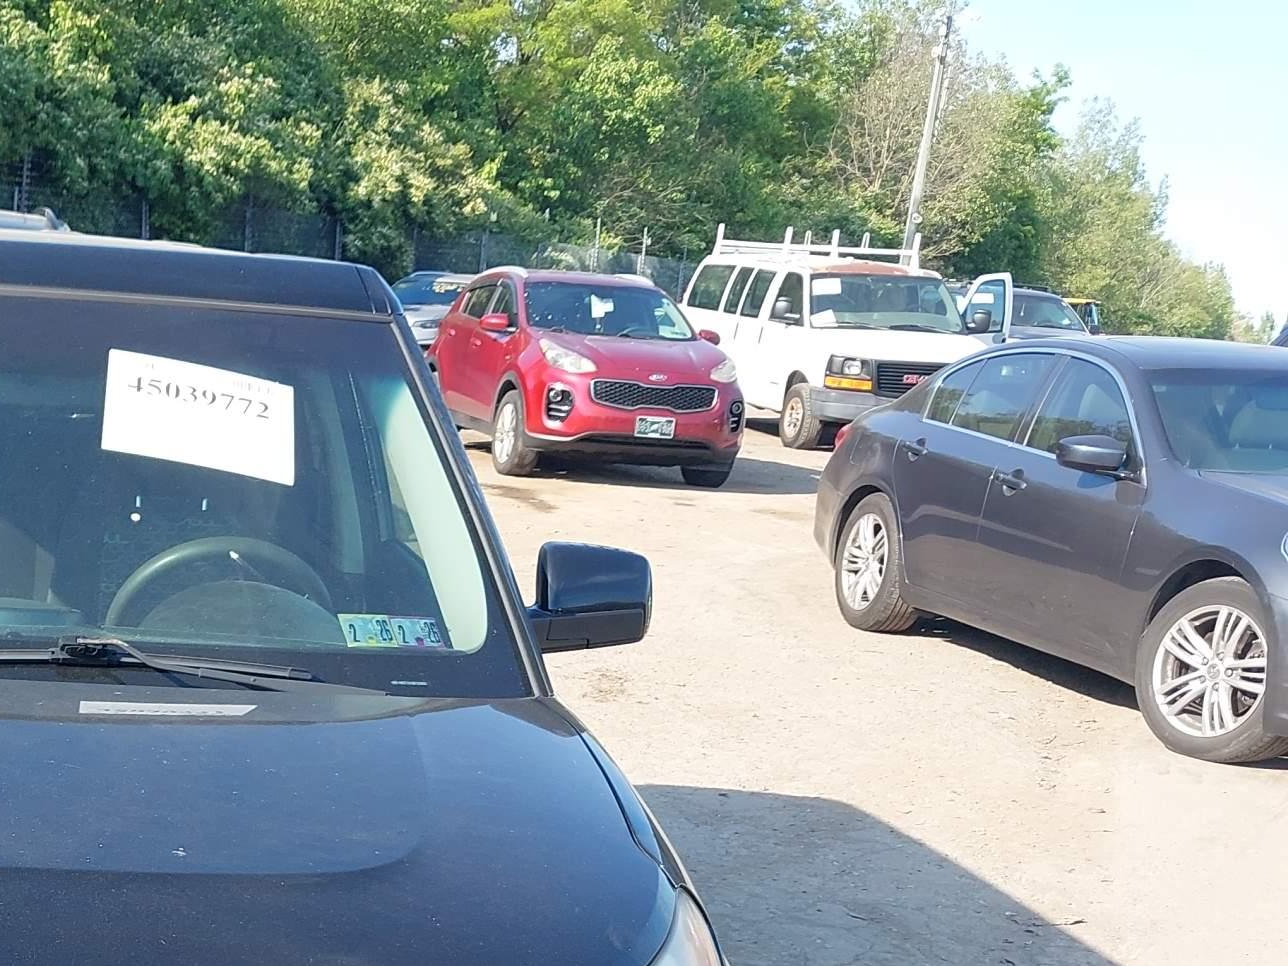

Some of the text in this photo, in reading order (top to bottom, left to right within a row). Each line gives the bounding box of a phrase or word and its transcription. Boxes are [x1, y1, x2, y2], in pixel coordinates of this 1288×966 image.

[127, 376, 270, 420] 45039772
[348, 620, 393, 642] 2 26
[398, 622, 441, 643] 2 26
